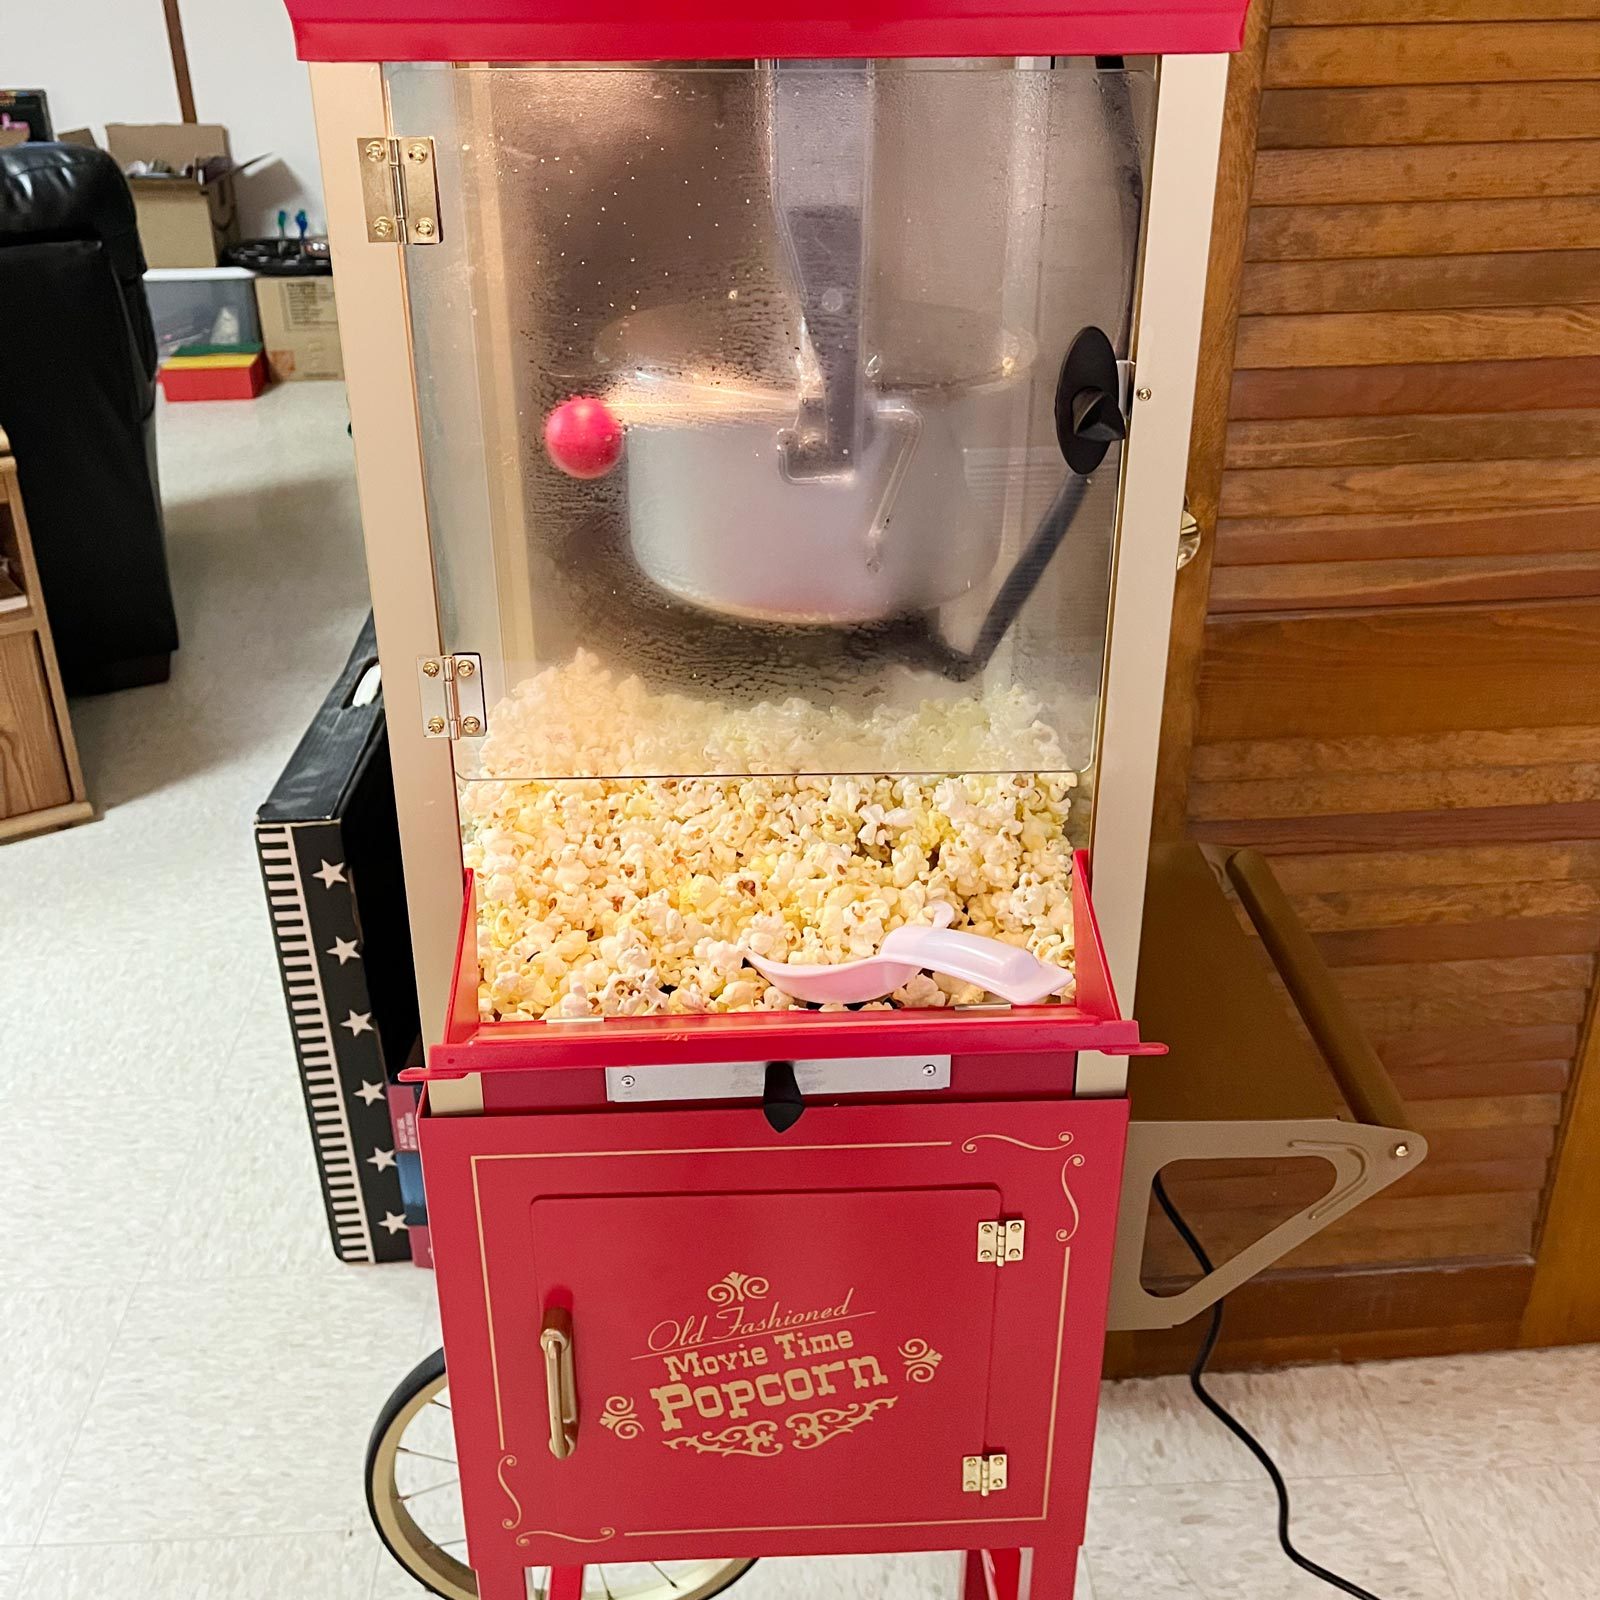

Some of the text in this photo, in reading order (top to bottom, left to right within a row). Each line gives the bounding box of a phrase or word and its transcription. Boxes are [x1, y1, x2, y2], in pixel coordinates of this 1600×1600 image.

[648, 1287, 854, 1351] Old Fashioned
[663, 1330, 854, 1382] Movie Time
[650, 1355, 889, 1432] Popcorn
